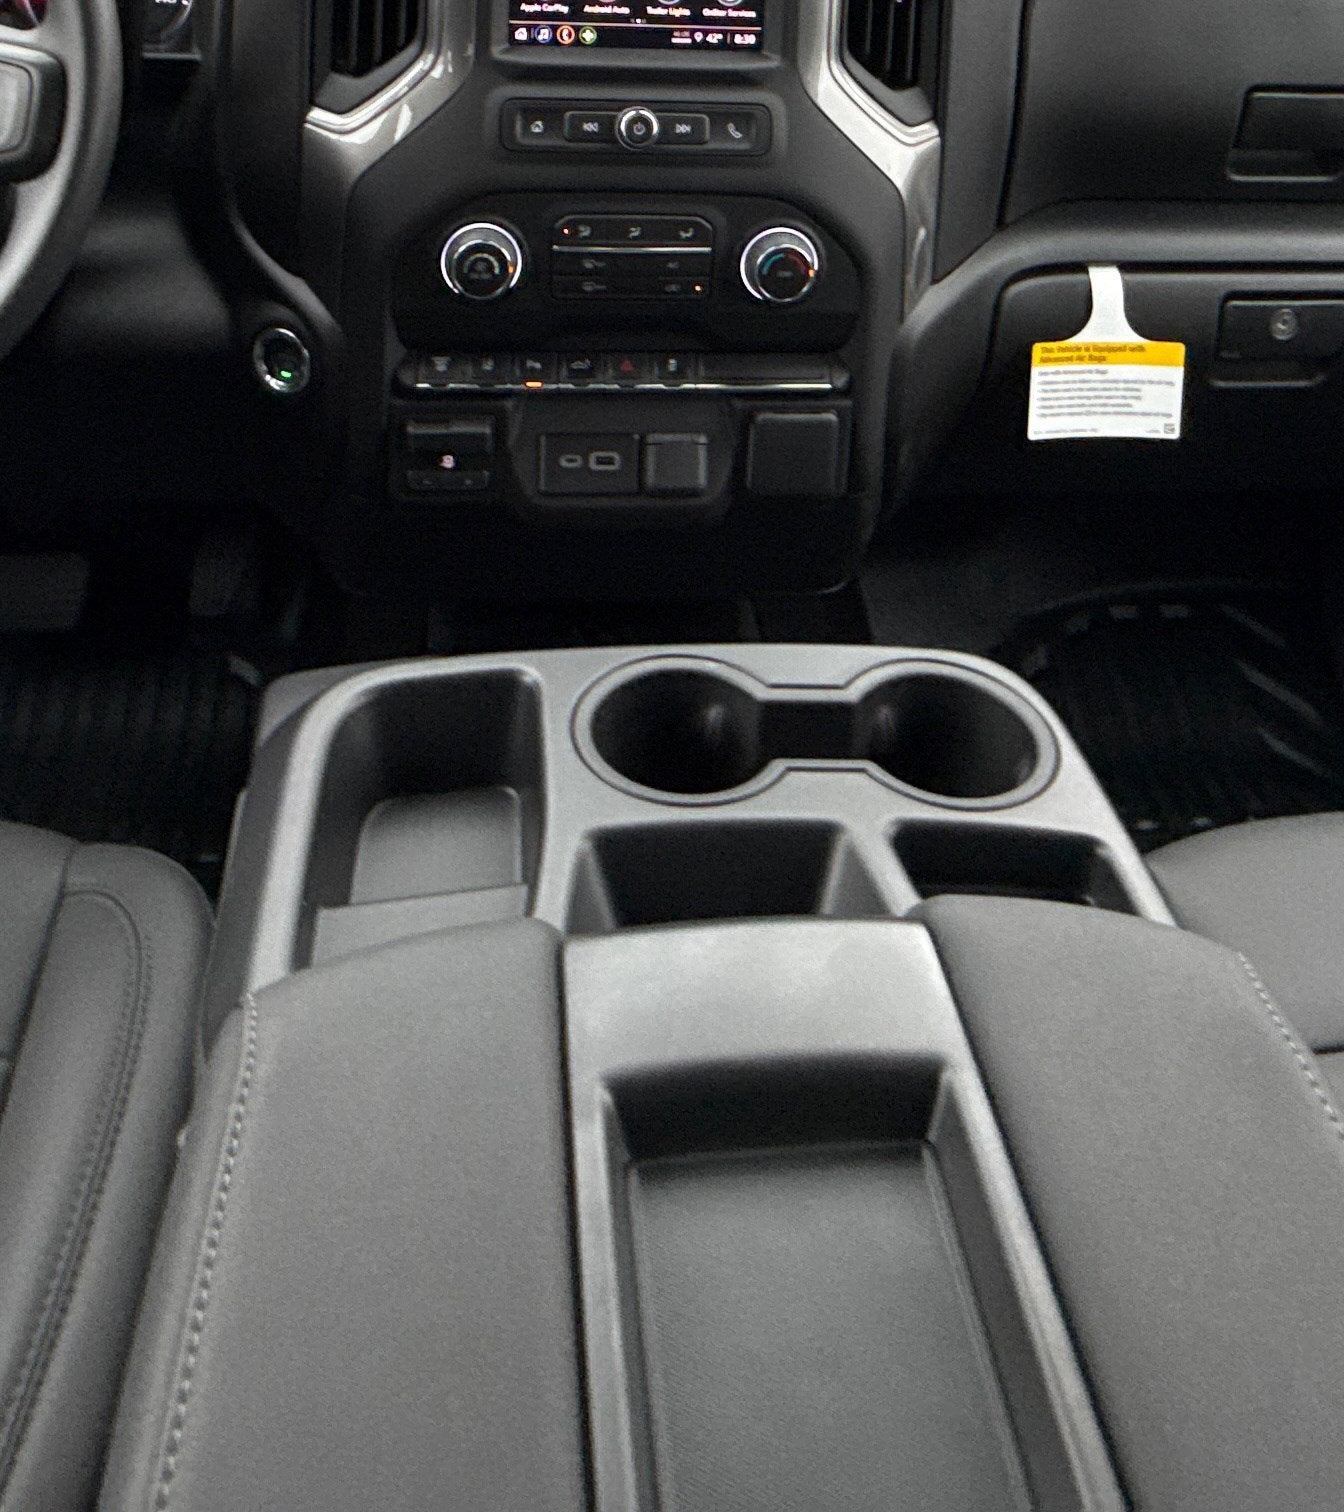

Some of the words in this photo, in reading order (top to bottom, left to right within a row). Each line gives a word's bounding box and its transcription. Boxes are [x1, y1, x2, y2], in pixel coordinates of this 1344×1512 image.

[519, 2, 542, 13] Apple
[542, 3, 570, 14] CarPlay
[583, 4, 612, 14] Android
[612, 5, 631, 15] Auto
[668, 7, 691, 17] Lights
